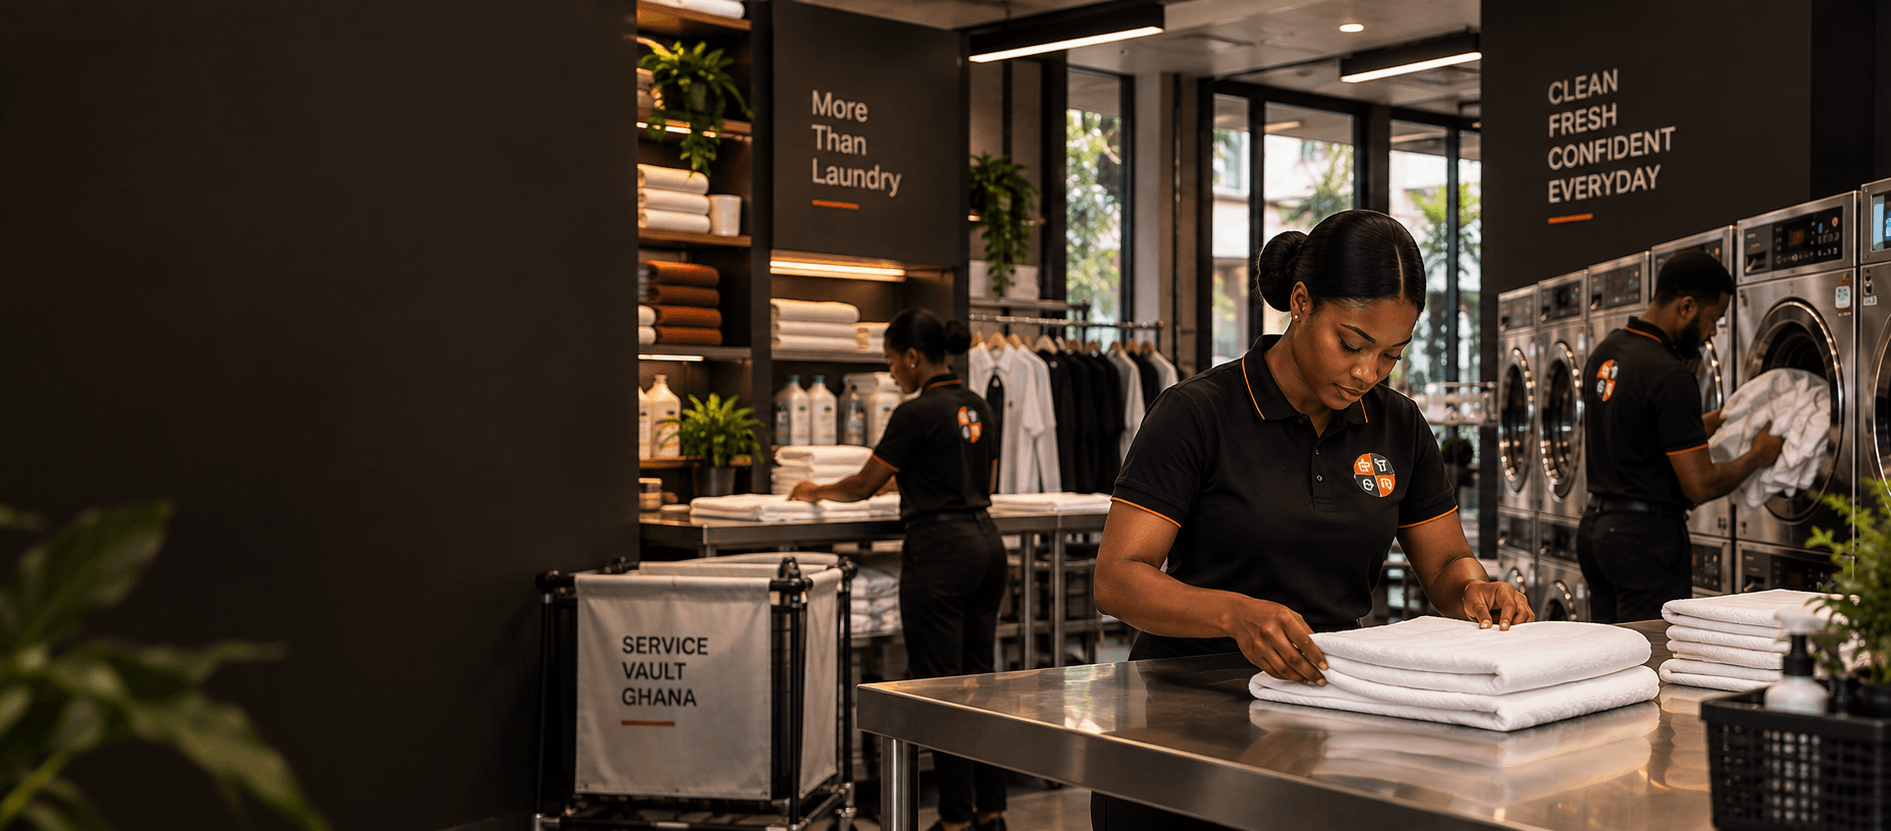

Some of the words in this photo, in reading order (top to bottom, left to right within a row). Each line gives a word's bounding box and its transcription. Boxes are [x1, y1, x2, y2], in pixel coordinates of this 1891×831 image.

[1548, 68, 1618, 105] CLEAN
[812, 89, 868, 123] More
[1549, 102, 1617, 138] FRESH
[811, 123, 867, 156] Than
[1548, 126, 1676, 170] CONFIDENT
[812, 157, 902, 198] Laundry
[1548, 164, 1661, 204] EVERYDAY
[621, 635, 709, 656] SERVICE
[621, 661, 687, 681] VAULT
[621, 686, 698, 708] GHANA
